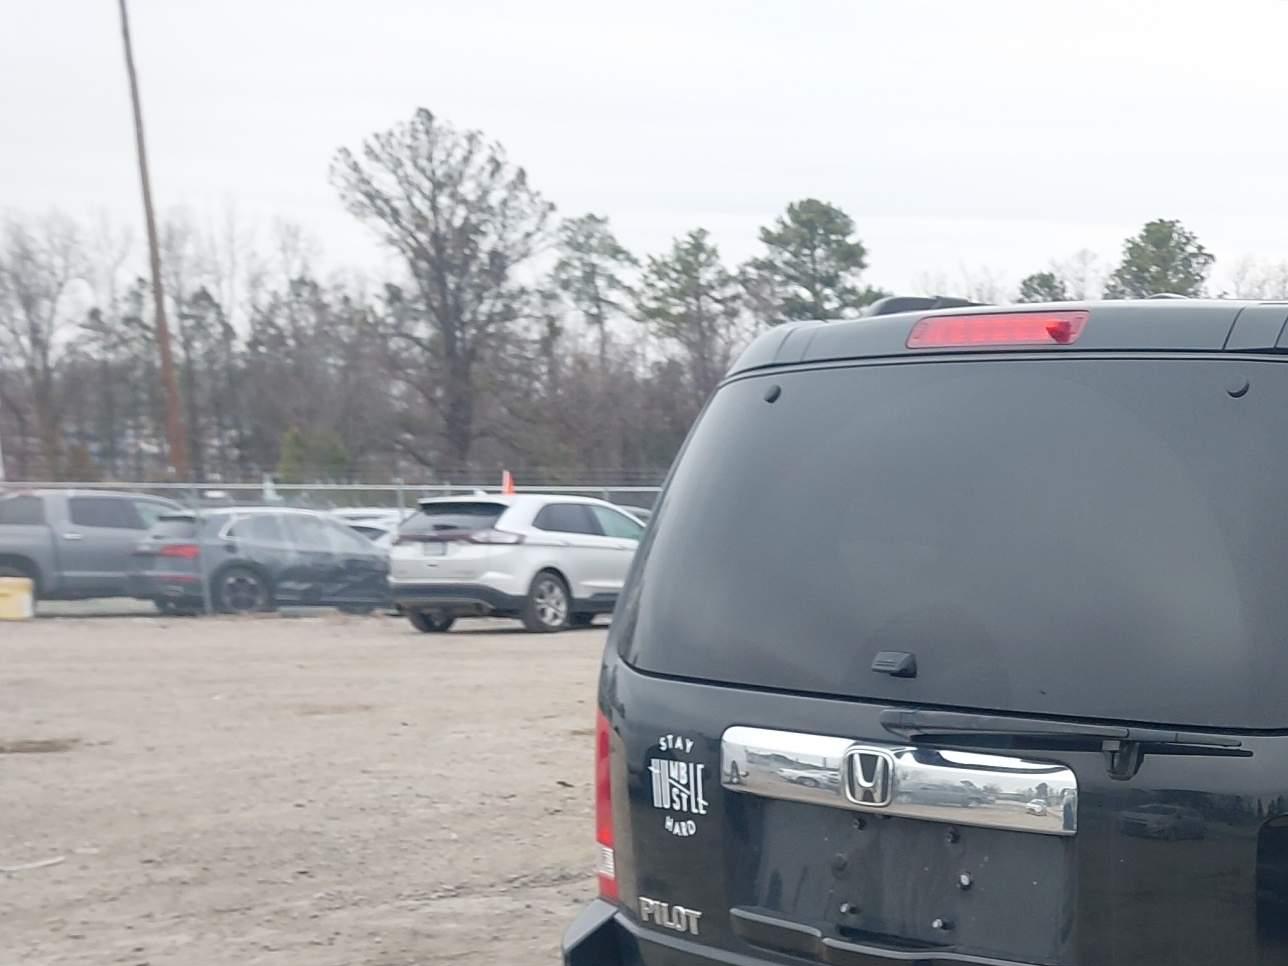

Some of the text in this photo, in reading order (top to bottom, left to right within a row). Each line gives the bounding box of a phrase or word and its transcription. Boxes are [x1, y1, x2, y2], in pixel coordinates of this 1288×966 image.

[658, 734, 695, 753] STAY
[664, 816, 697, 836] HARD
[638, 896, 703, 935] PILOT
